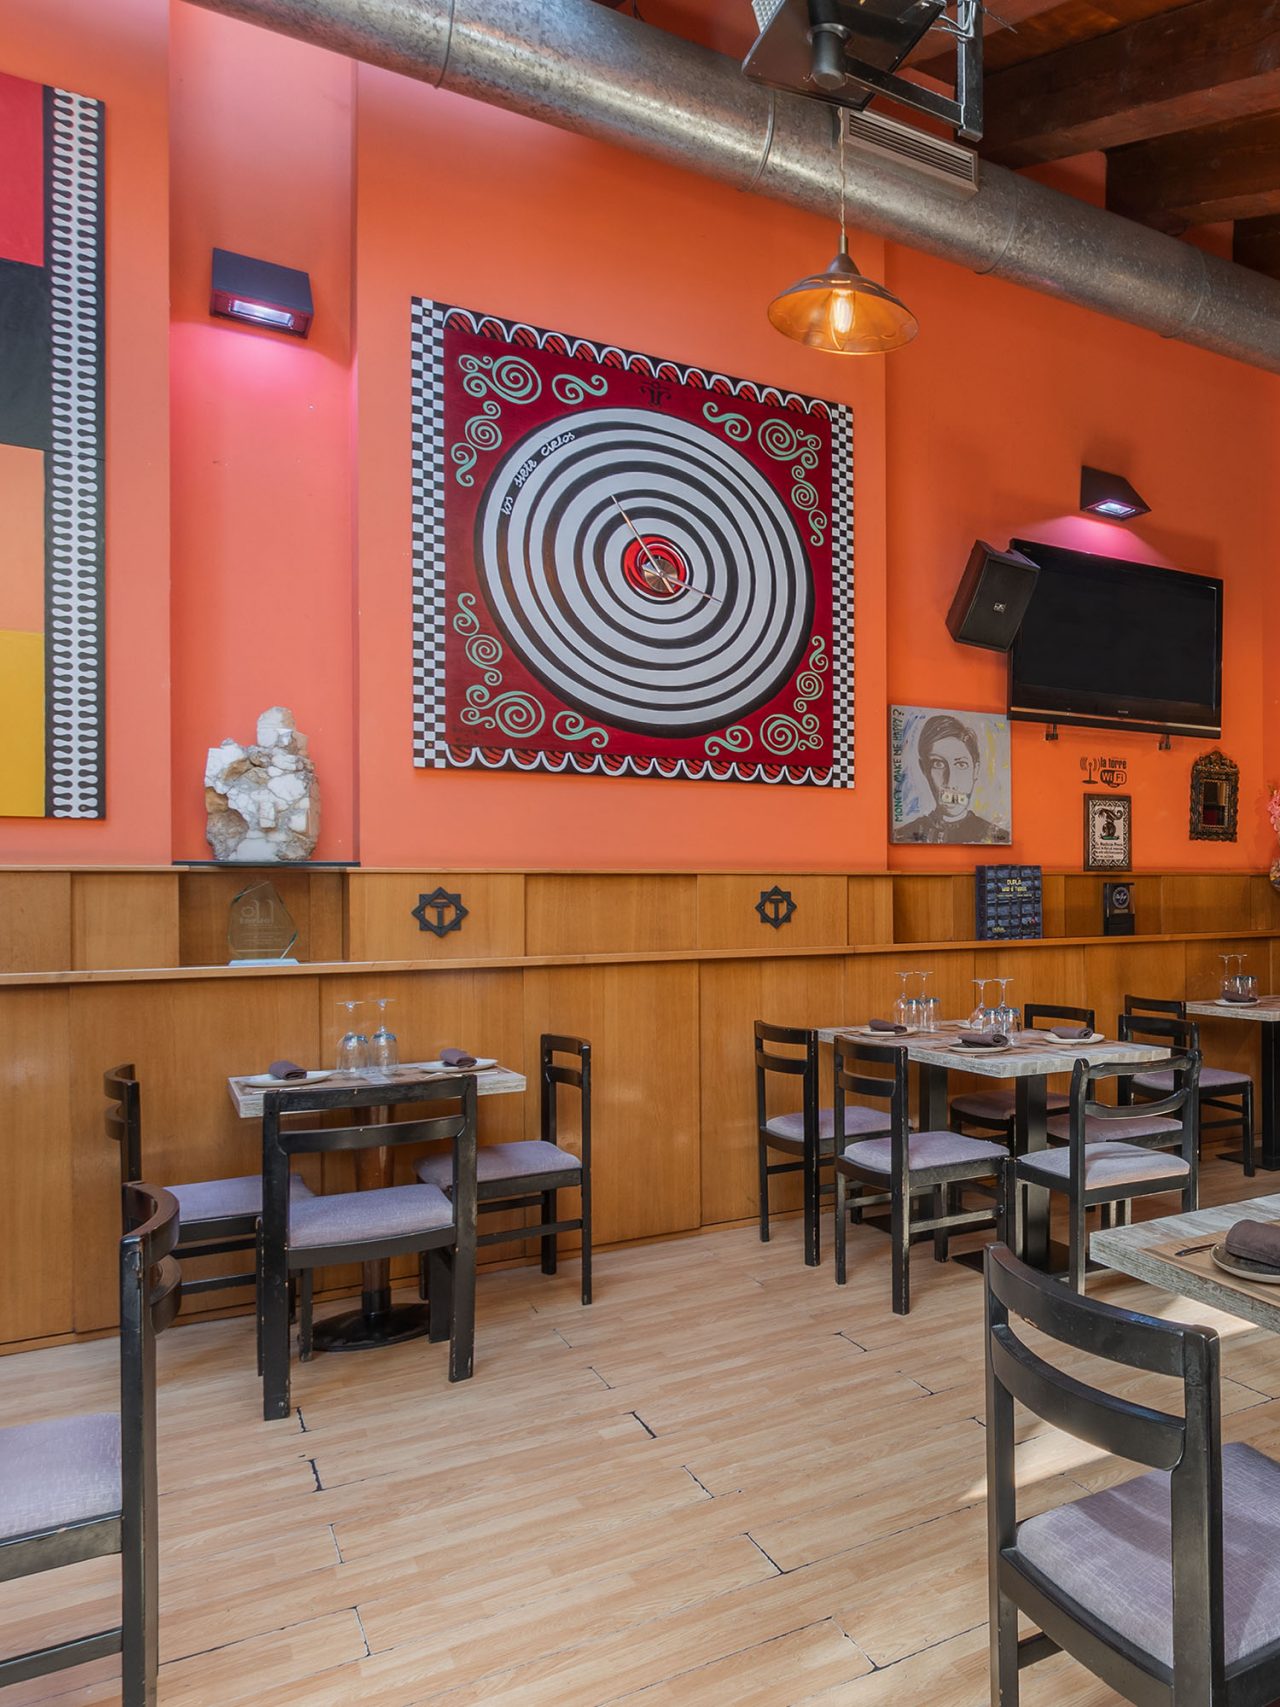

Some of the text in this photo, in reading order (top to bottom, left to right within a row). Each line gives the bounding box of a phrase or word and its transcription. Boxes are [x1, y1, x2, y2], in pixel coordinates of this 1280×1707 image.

[892, 708, 905, 822] MONEY MAKE ME HAPPY?
[1100, 756, 1127, 770] la torre
